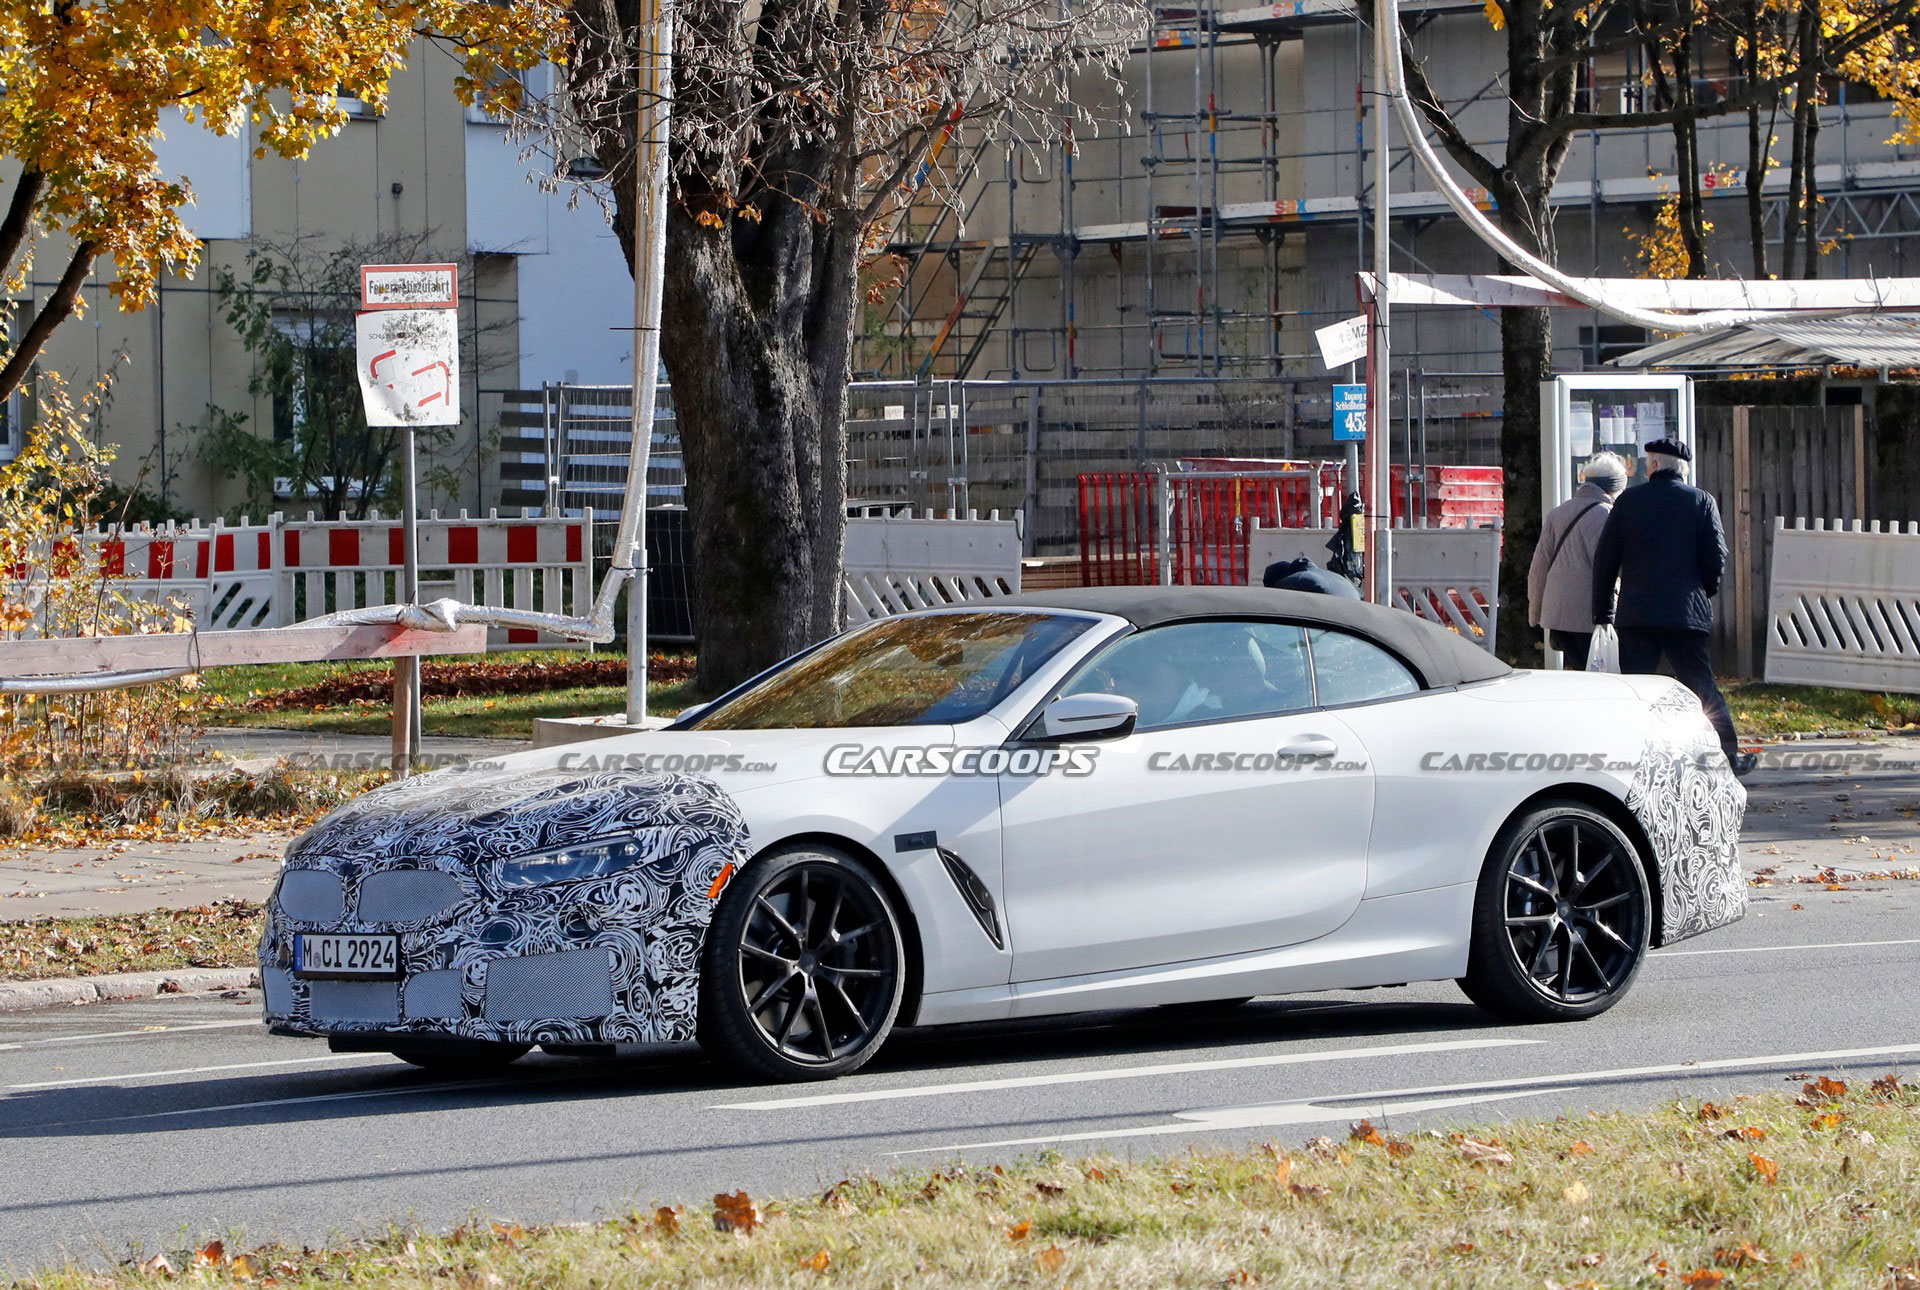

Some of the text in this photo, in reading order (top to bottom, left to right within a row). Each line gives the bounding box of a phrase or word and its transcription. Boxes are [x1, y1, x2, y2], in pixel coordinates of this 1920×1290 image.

[303, 939, 394, 969] M CI 2924
